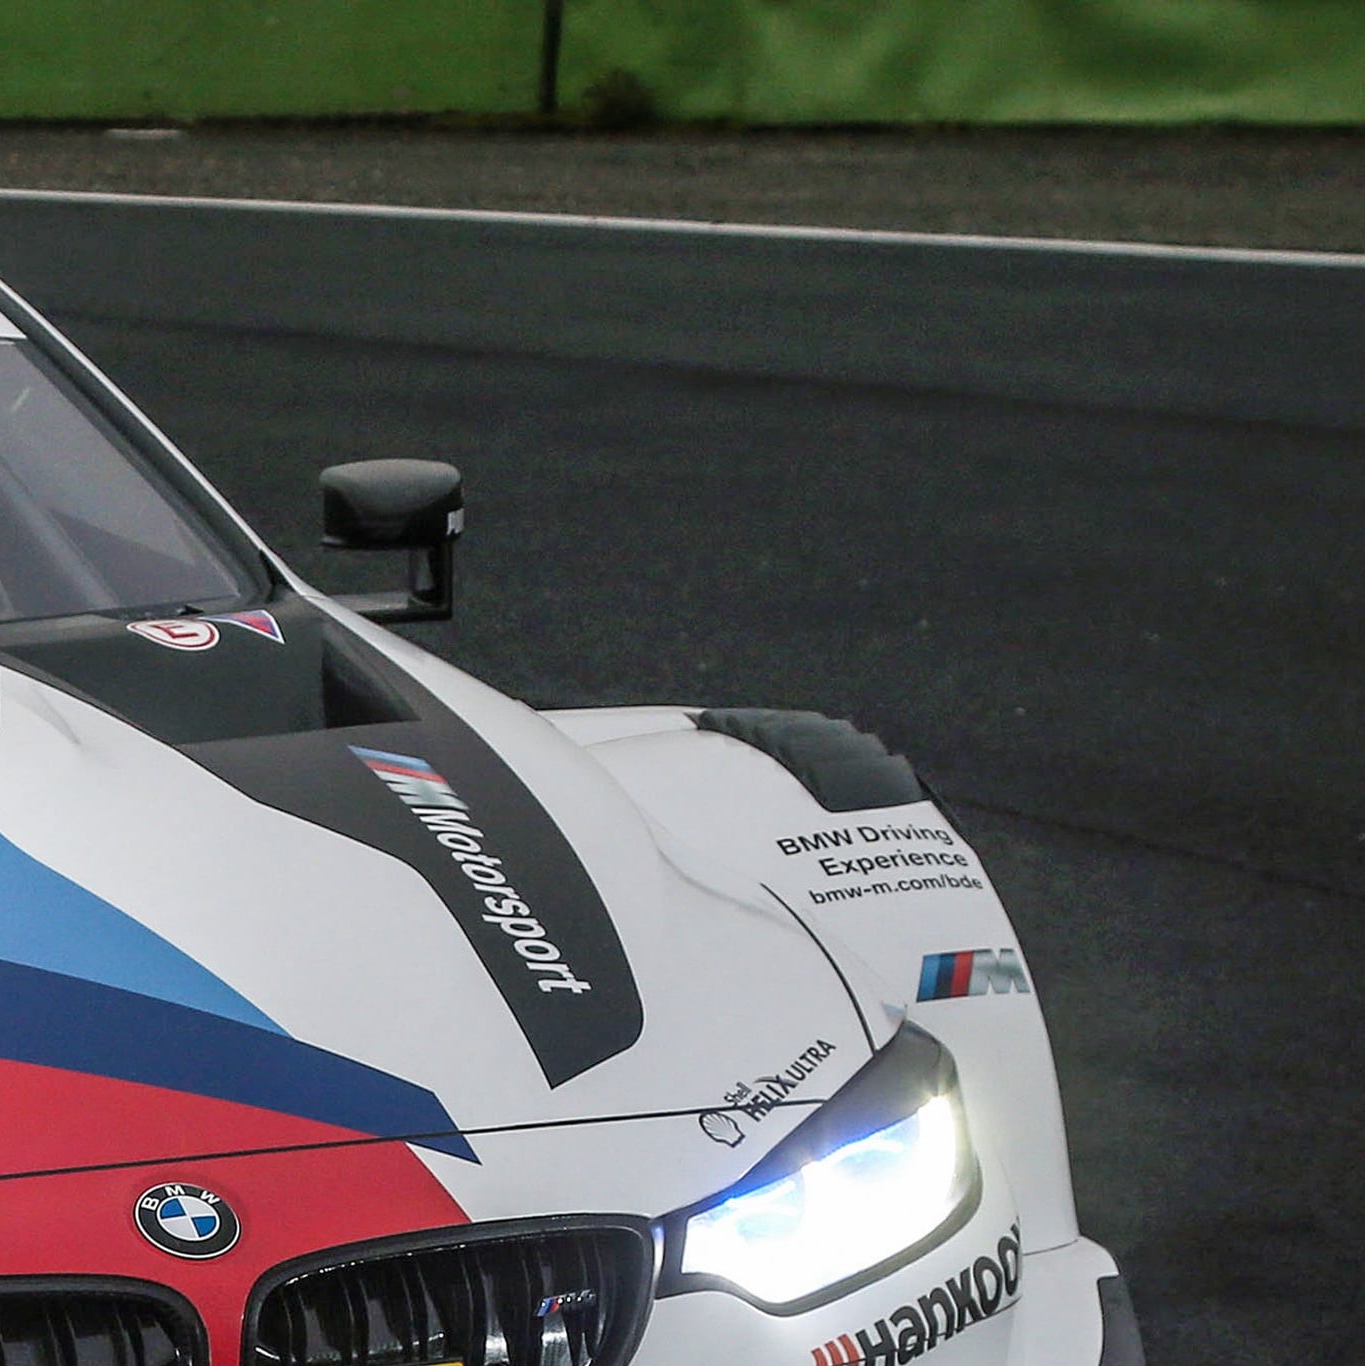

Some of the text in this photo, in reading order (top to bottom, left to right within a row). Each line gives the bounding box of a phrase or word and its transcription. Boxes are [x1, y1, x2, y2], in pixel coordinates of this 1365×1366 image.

[777, 823, 954, 857] BMW Driving
[819, 849, 970, 878] Experience
[410, 807, 592, 995] Motorsport
[809, 874, 984, 906] bmw-m.com/bde
[785, 1039, 837, 1081] ULTRA
[141, 1184, 221, 1212] BMW
